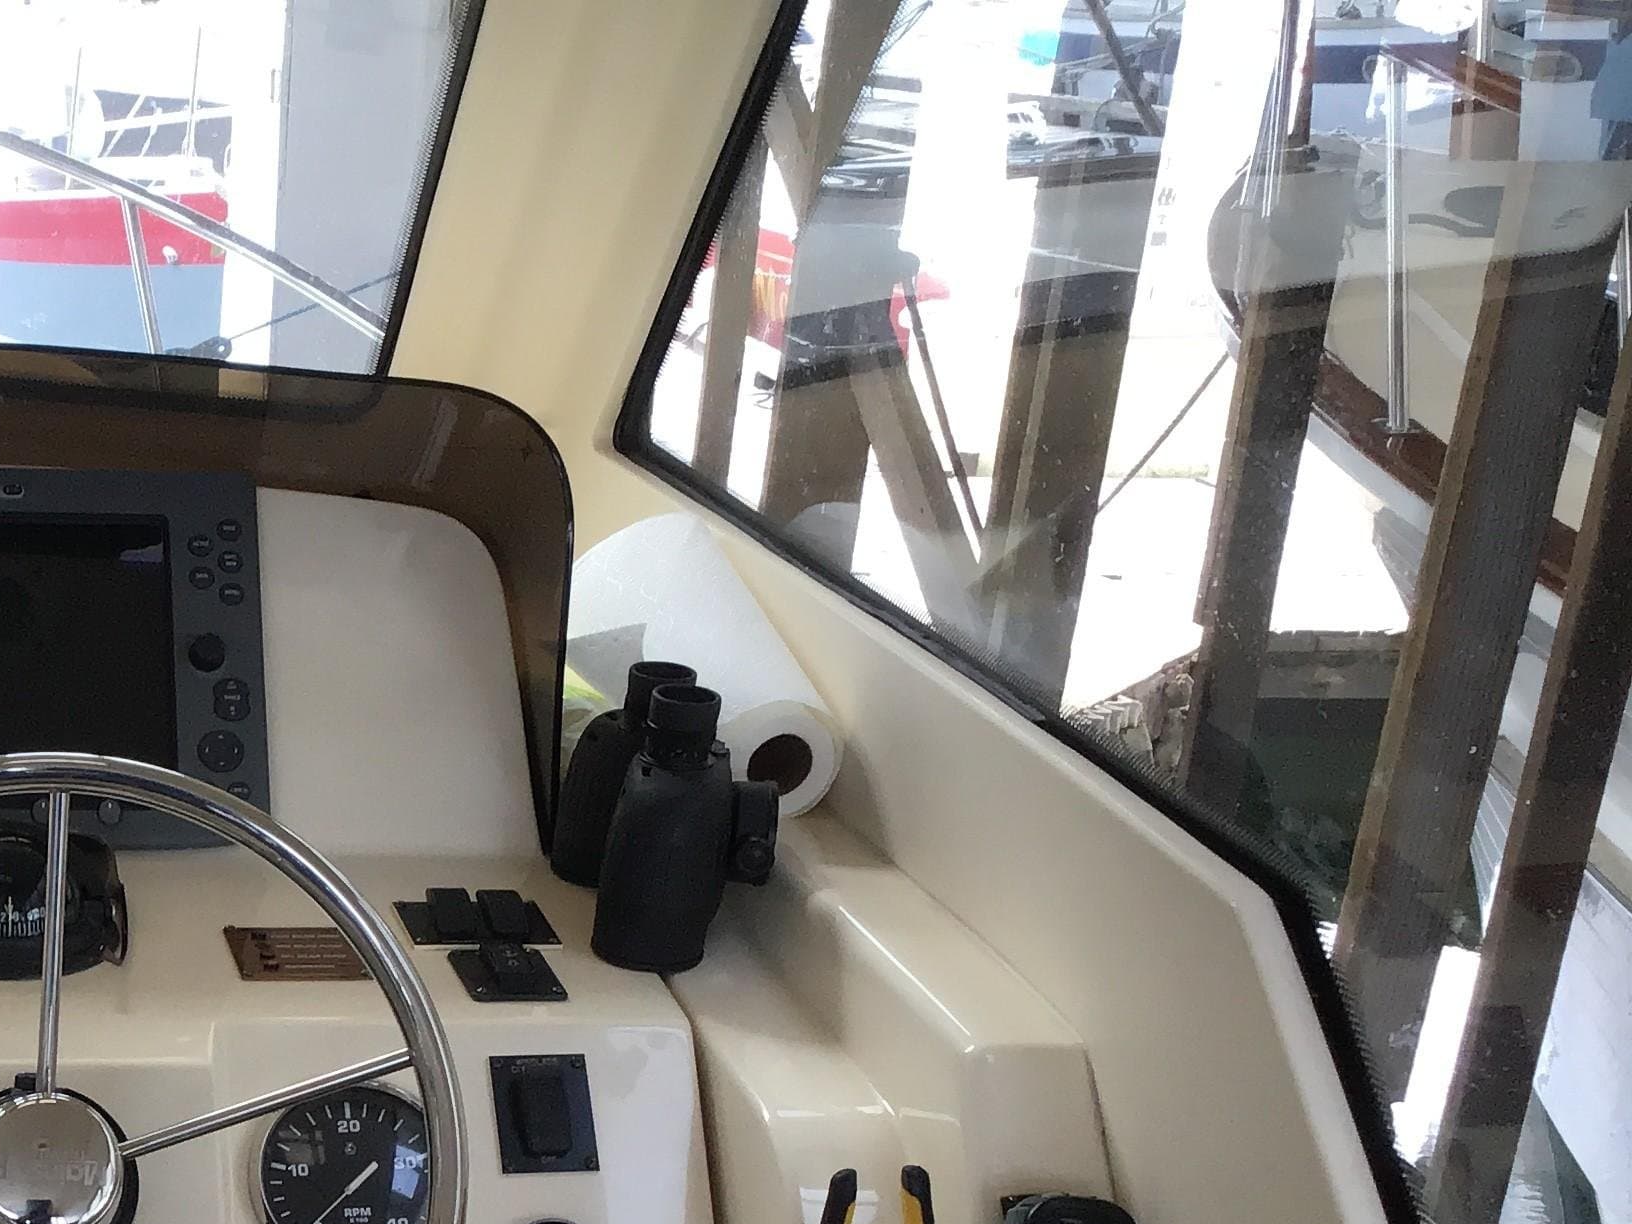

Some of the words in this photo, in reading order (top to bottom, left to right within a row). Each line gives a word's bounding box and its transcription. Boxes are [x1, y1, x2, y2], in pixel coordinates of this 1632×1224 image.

[337, 1120, 361, 1133] 20
[394, 1156, 417, 1169] 30
[288, 1163, 309, 1177] 10
[344, 1207, 372, 1218] RPM
